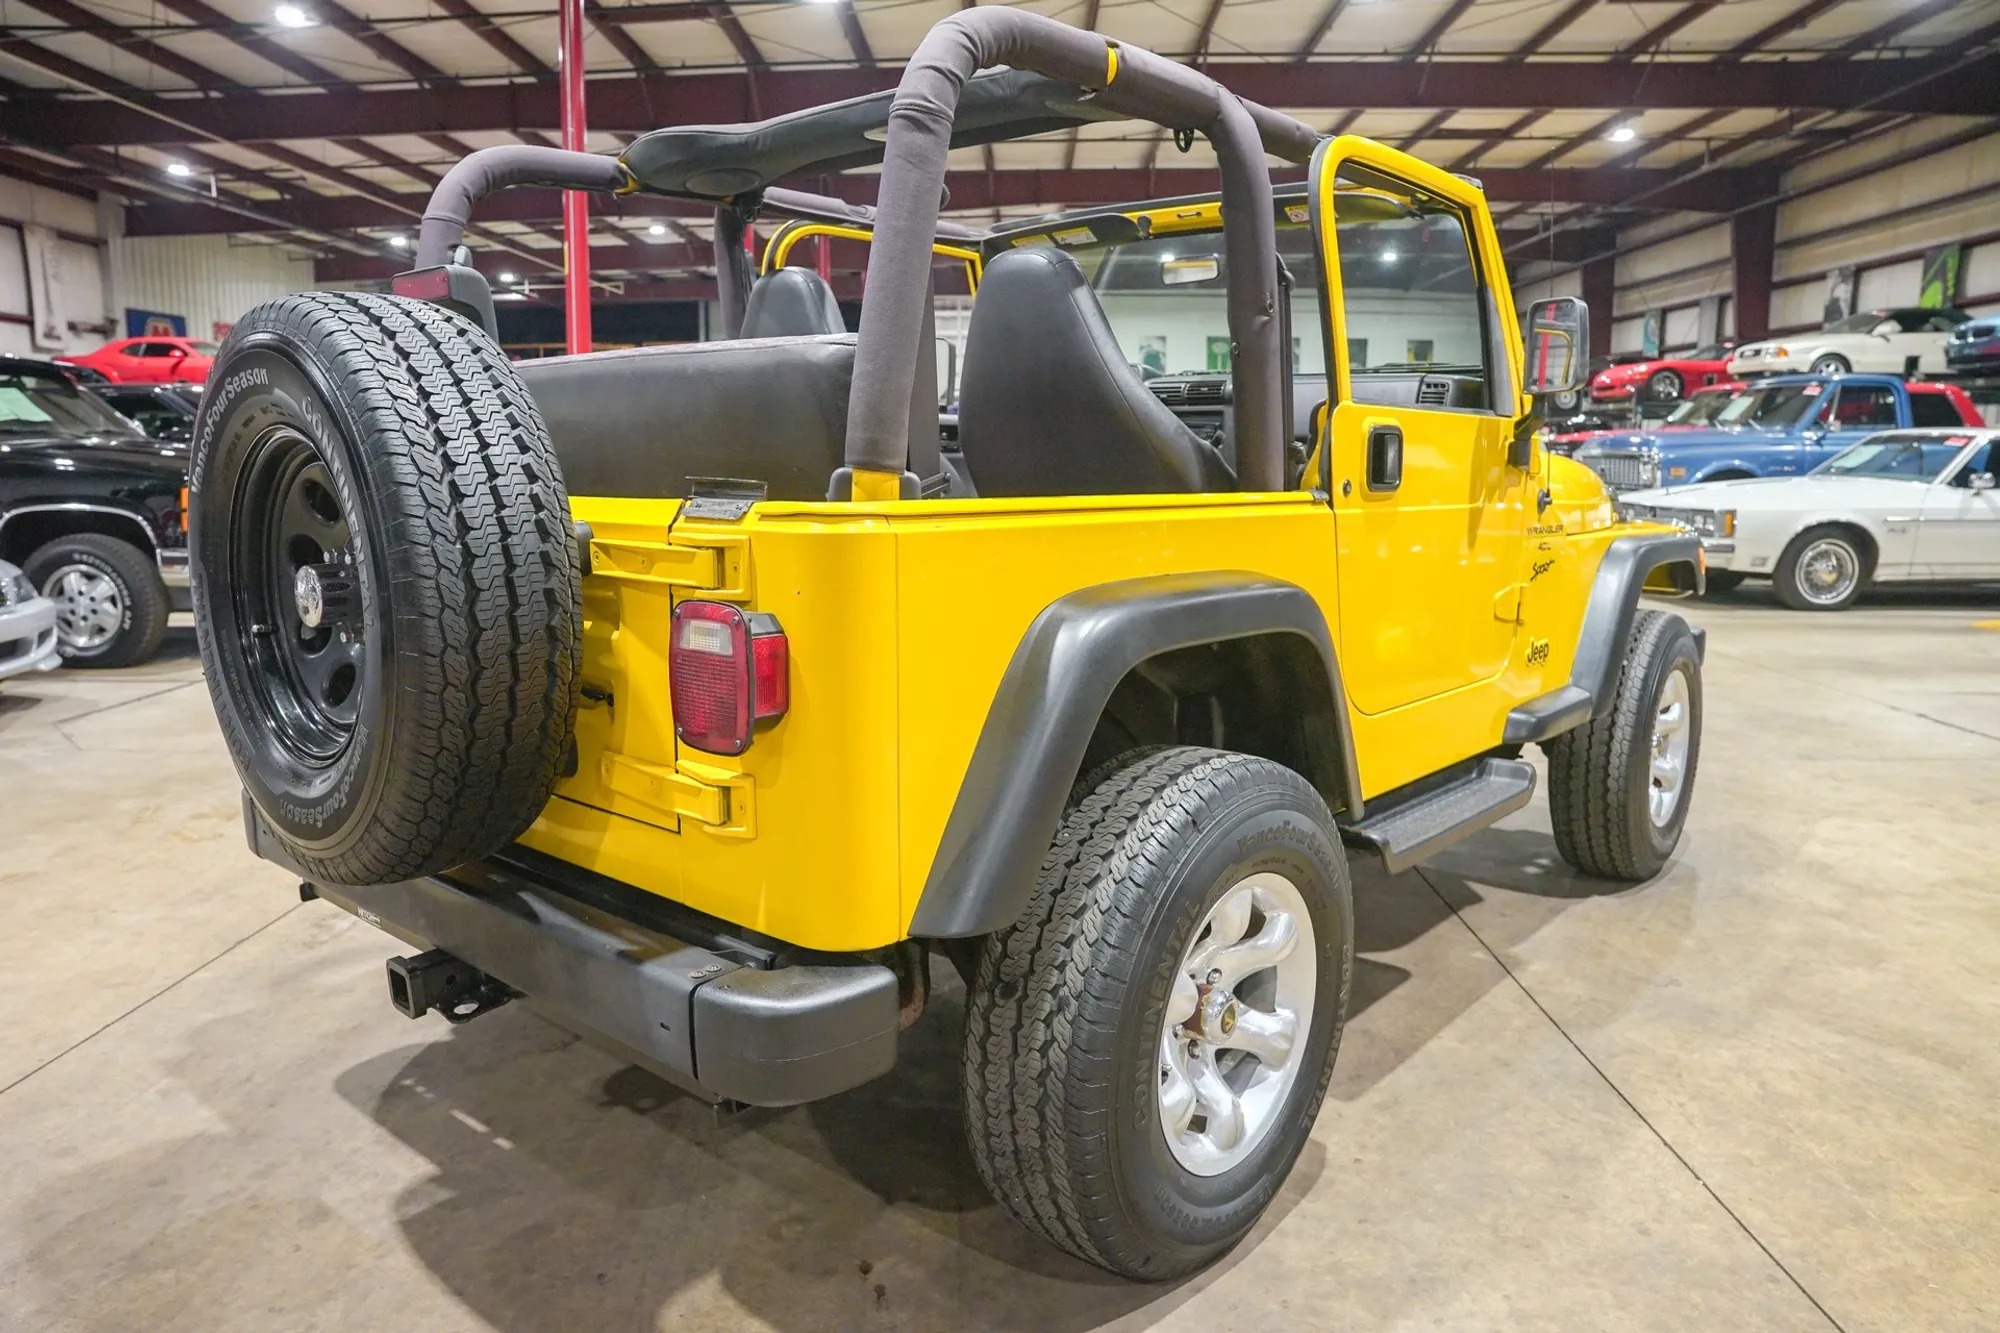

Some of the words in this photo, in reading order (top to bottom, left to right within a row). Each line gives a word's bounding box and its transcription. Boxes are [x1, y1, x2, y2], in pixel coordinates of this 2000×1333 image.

[190, 367, 269, 494] VancoFourSeason
[302, 396, 374, 627] CONTINENTAL
[1527, 525, 1564, 536] WRANGLER
[1527, 641, 1549, 663] Jeep
